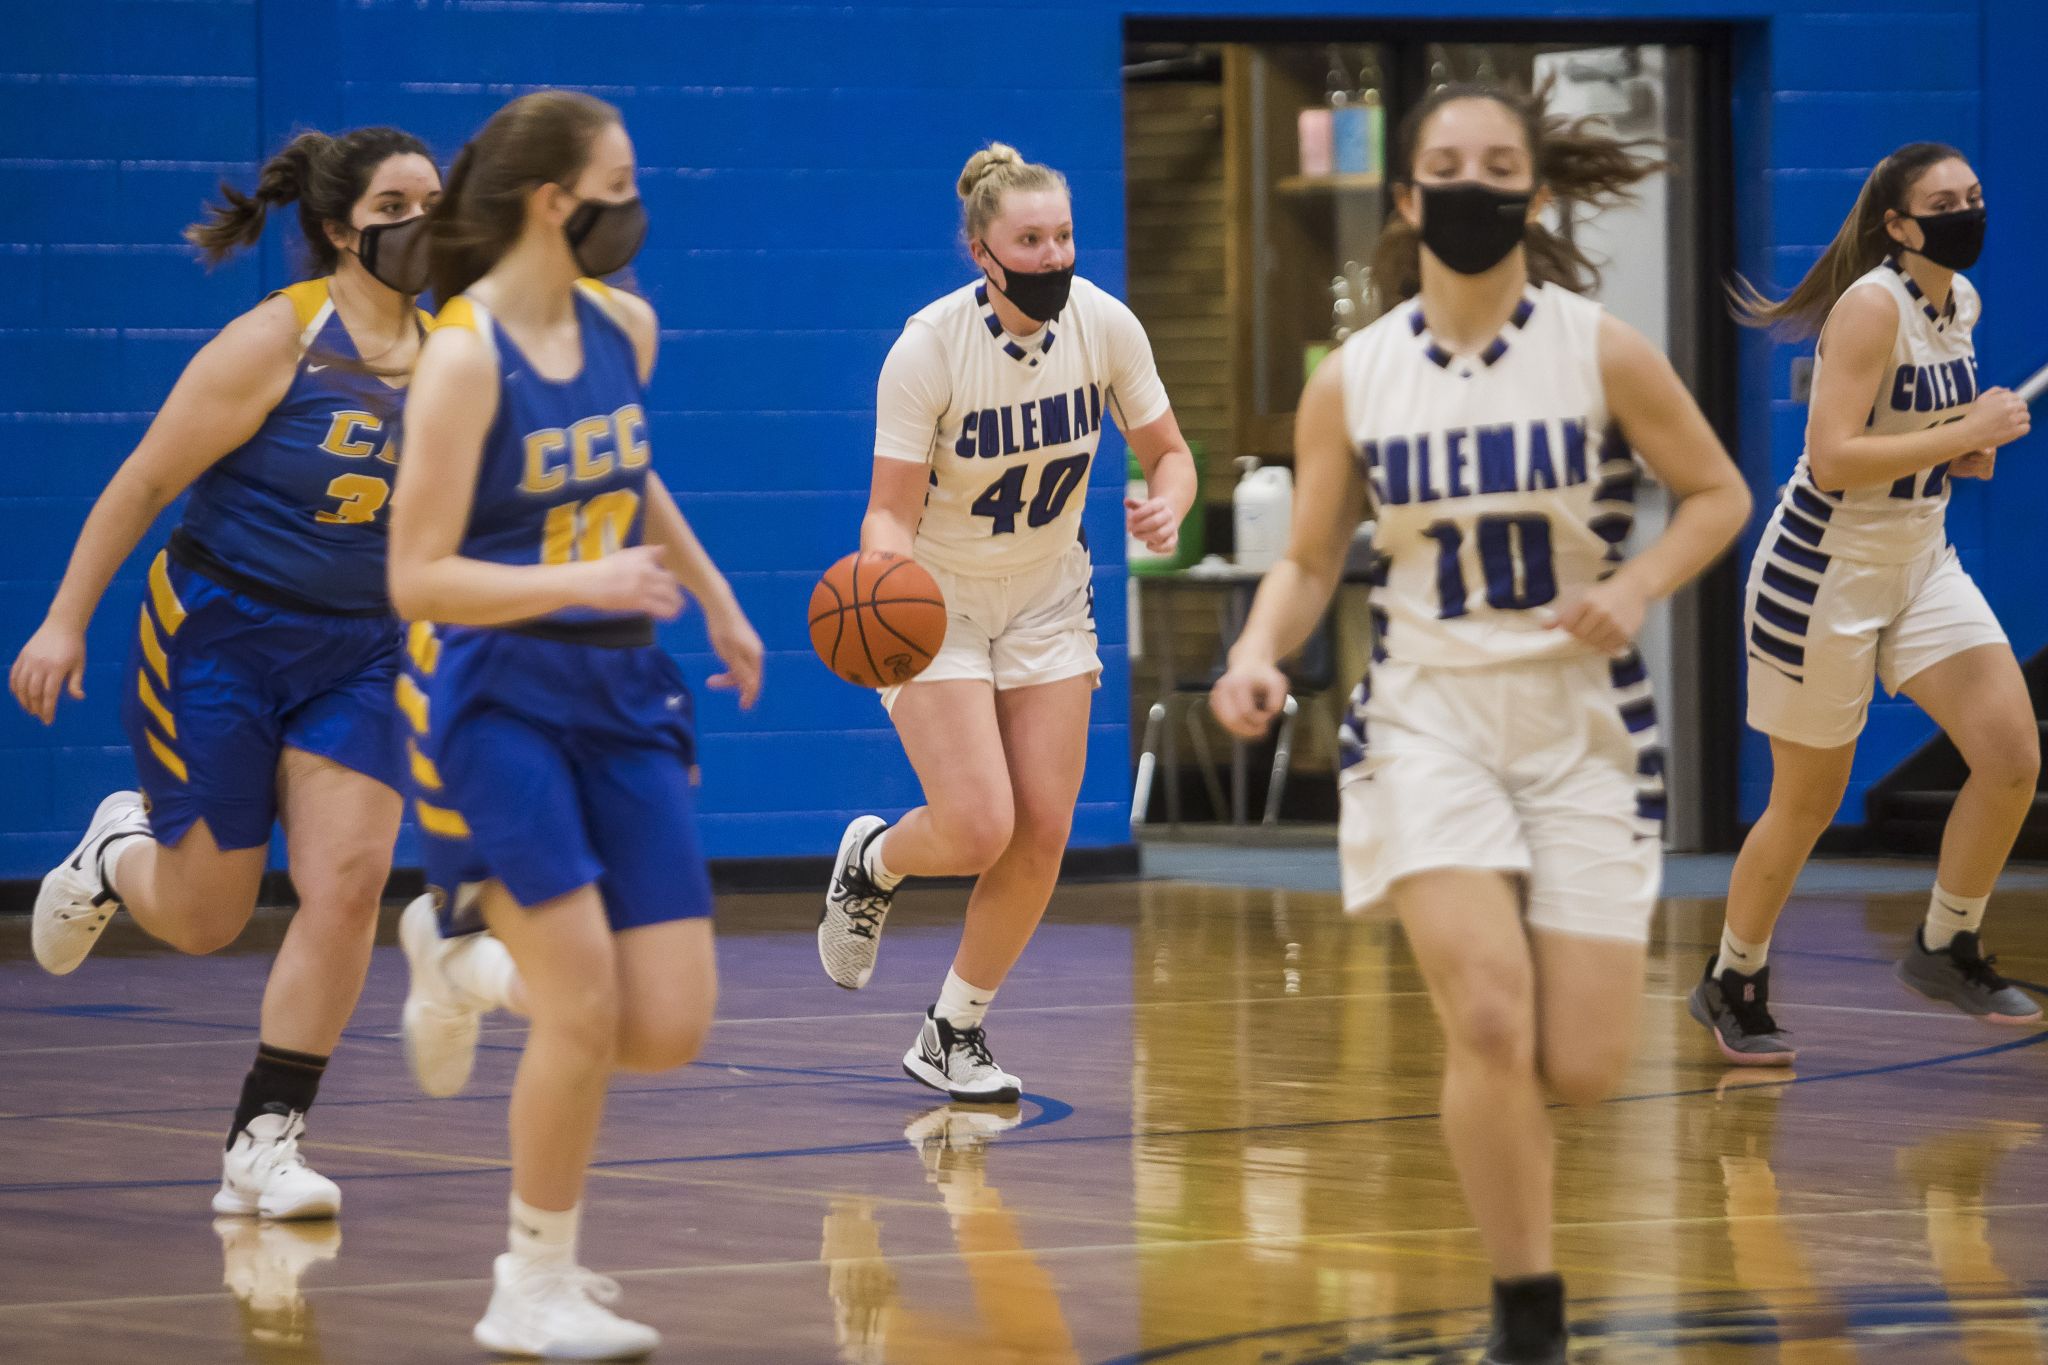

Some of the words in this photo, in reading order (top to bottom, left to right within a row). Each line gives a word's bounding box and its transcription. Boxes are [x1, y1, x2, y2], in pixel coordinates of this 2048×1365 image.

[517, 402, 651, 494] CCC
[970, 452, 1091, 537] 40
[1416, 510, 1557, 620] 10
